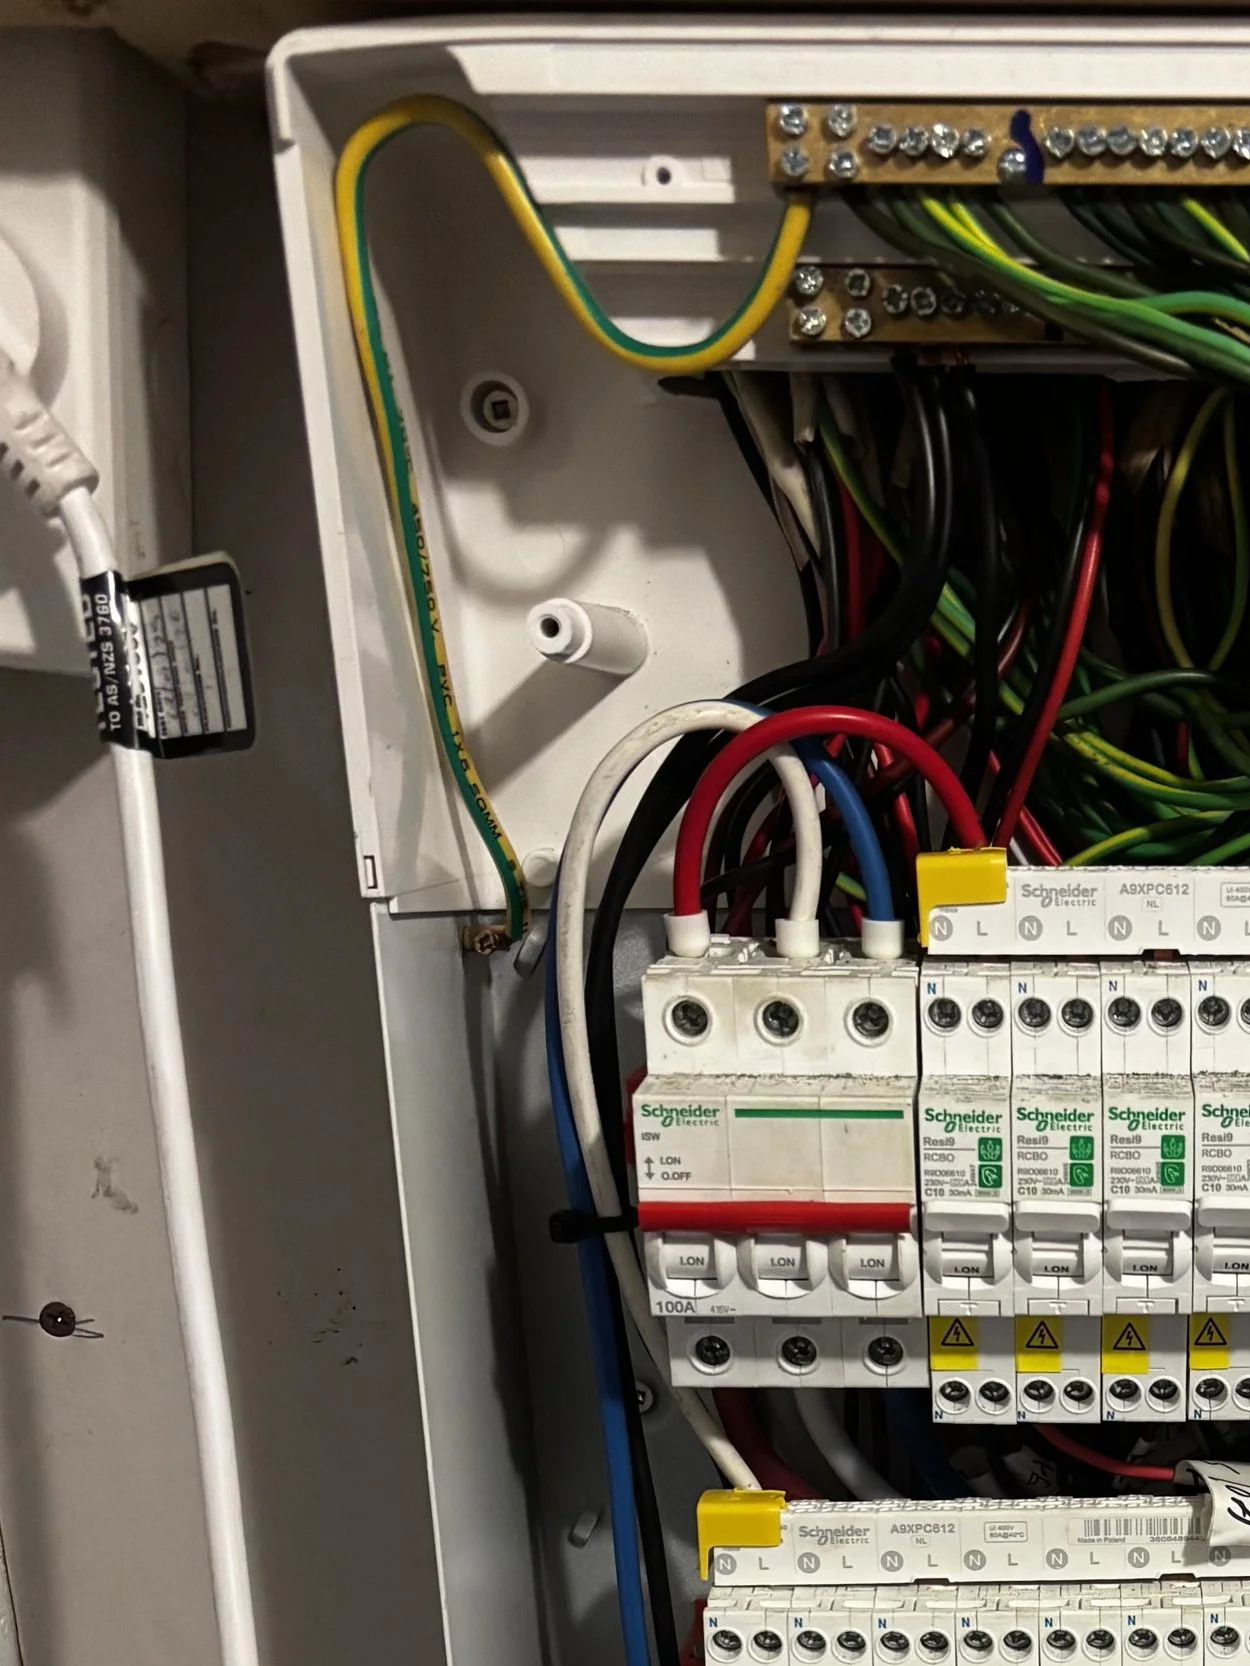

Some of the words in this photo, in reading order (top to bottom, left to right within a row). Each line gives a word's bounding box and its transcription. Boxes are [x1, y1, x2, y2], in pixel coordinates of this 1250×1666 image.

[98, 640, 117, 706] AS/NZS
[109, 710, 121, 731] TO
[1022, 884, 1098, 903] Schneider
[1120, 884, 1190, 896] A9XPC612
[1055, 898, 1096, 907] Electric
[641, 1104, 720, 1124] Schneider
[676, 1118, 719, 1126] Electric
[925, 1108, 1002, 1129] Schneider
[1017, 1107, 1094, 1128] Schneider
[1109, 1106, 1185, 1127] Schneider
[959, 1124, 1000, 1133] Electric
[1051, 1123, 1092, 1132] Electric
[1142, 1122, 1184, 1130] Electric
[656, 1302, 695, 1313] 100A
[800, 1525, 870, 1542] Schneider
